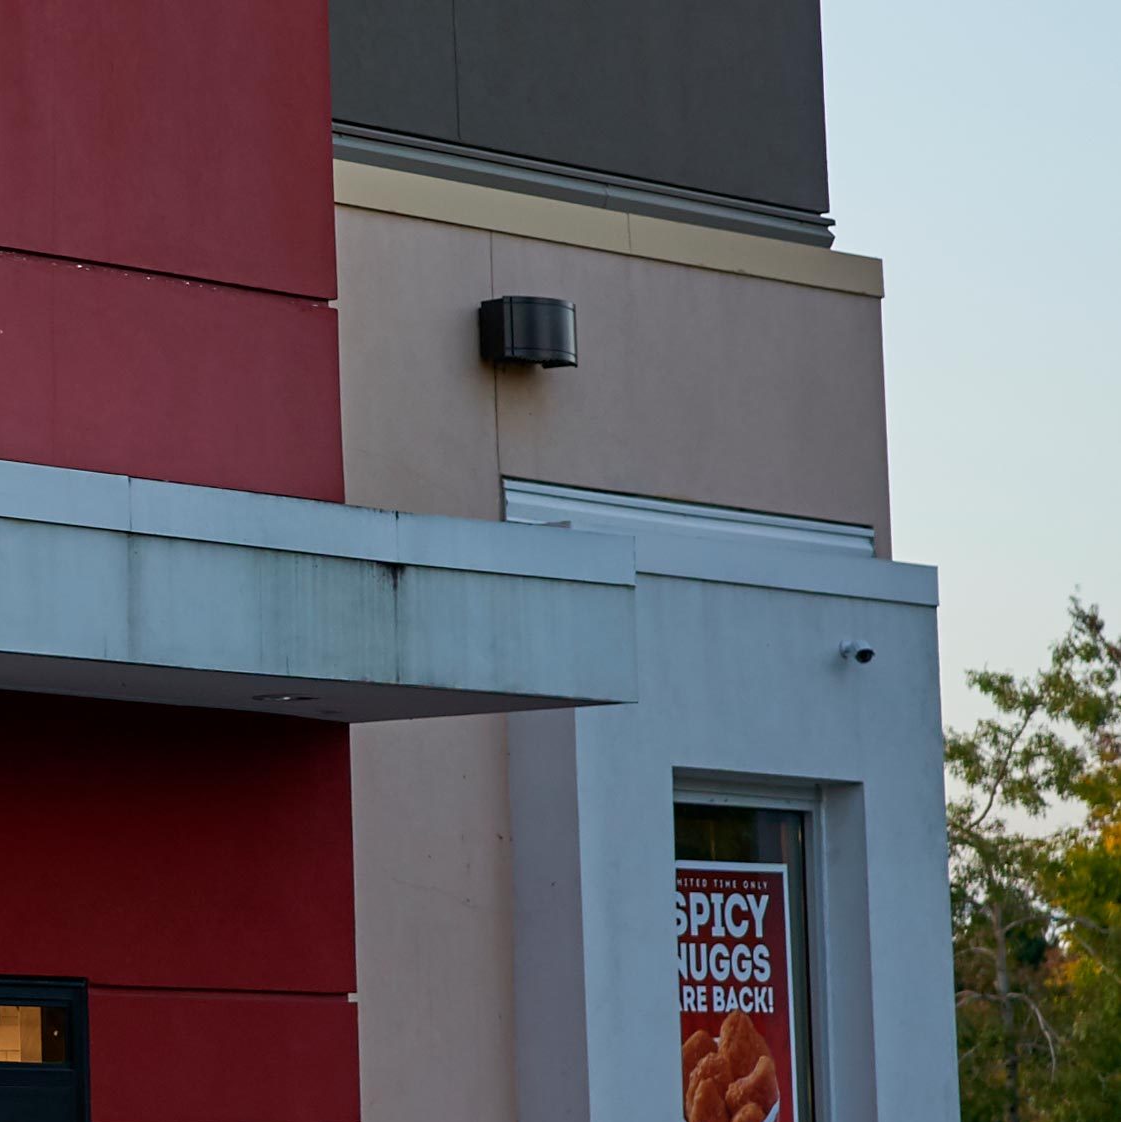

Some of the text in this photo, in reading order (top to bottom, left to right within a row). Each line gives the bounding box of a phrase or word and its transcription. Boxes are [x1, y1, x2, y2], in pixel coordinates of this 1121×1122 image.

[713, 879, 737, 889] TIME
[743, 880, 769, 891] ONLY
[676, 891, 769, 938] SPICY
[679, 985, 774, 1013] RE BACK!
